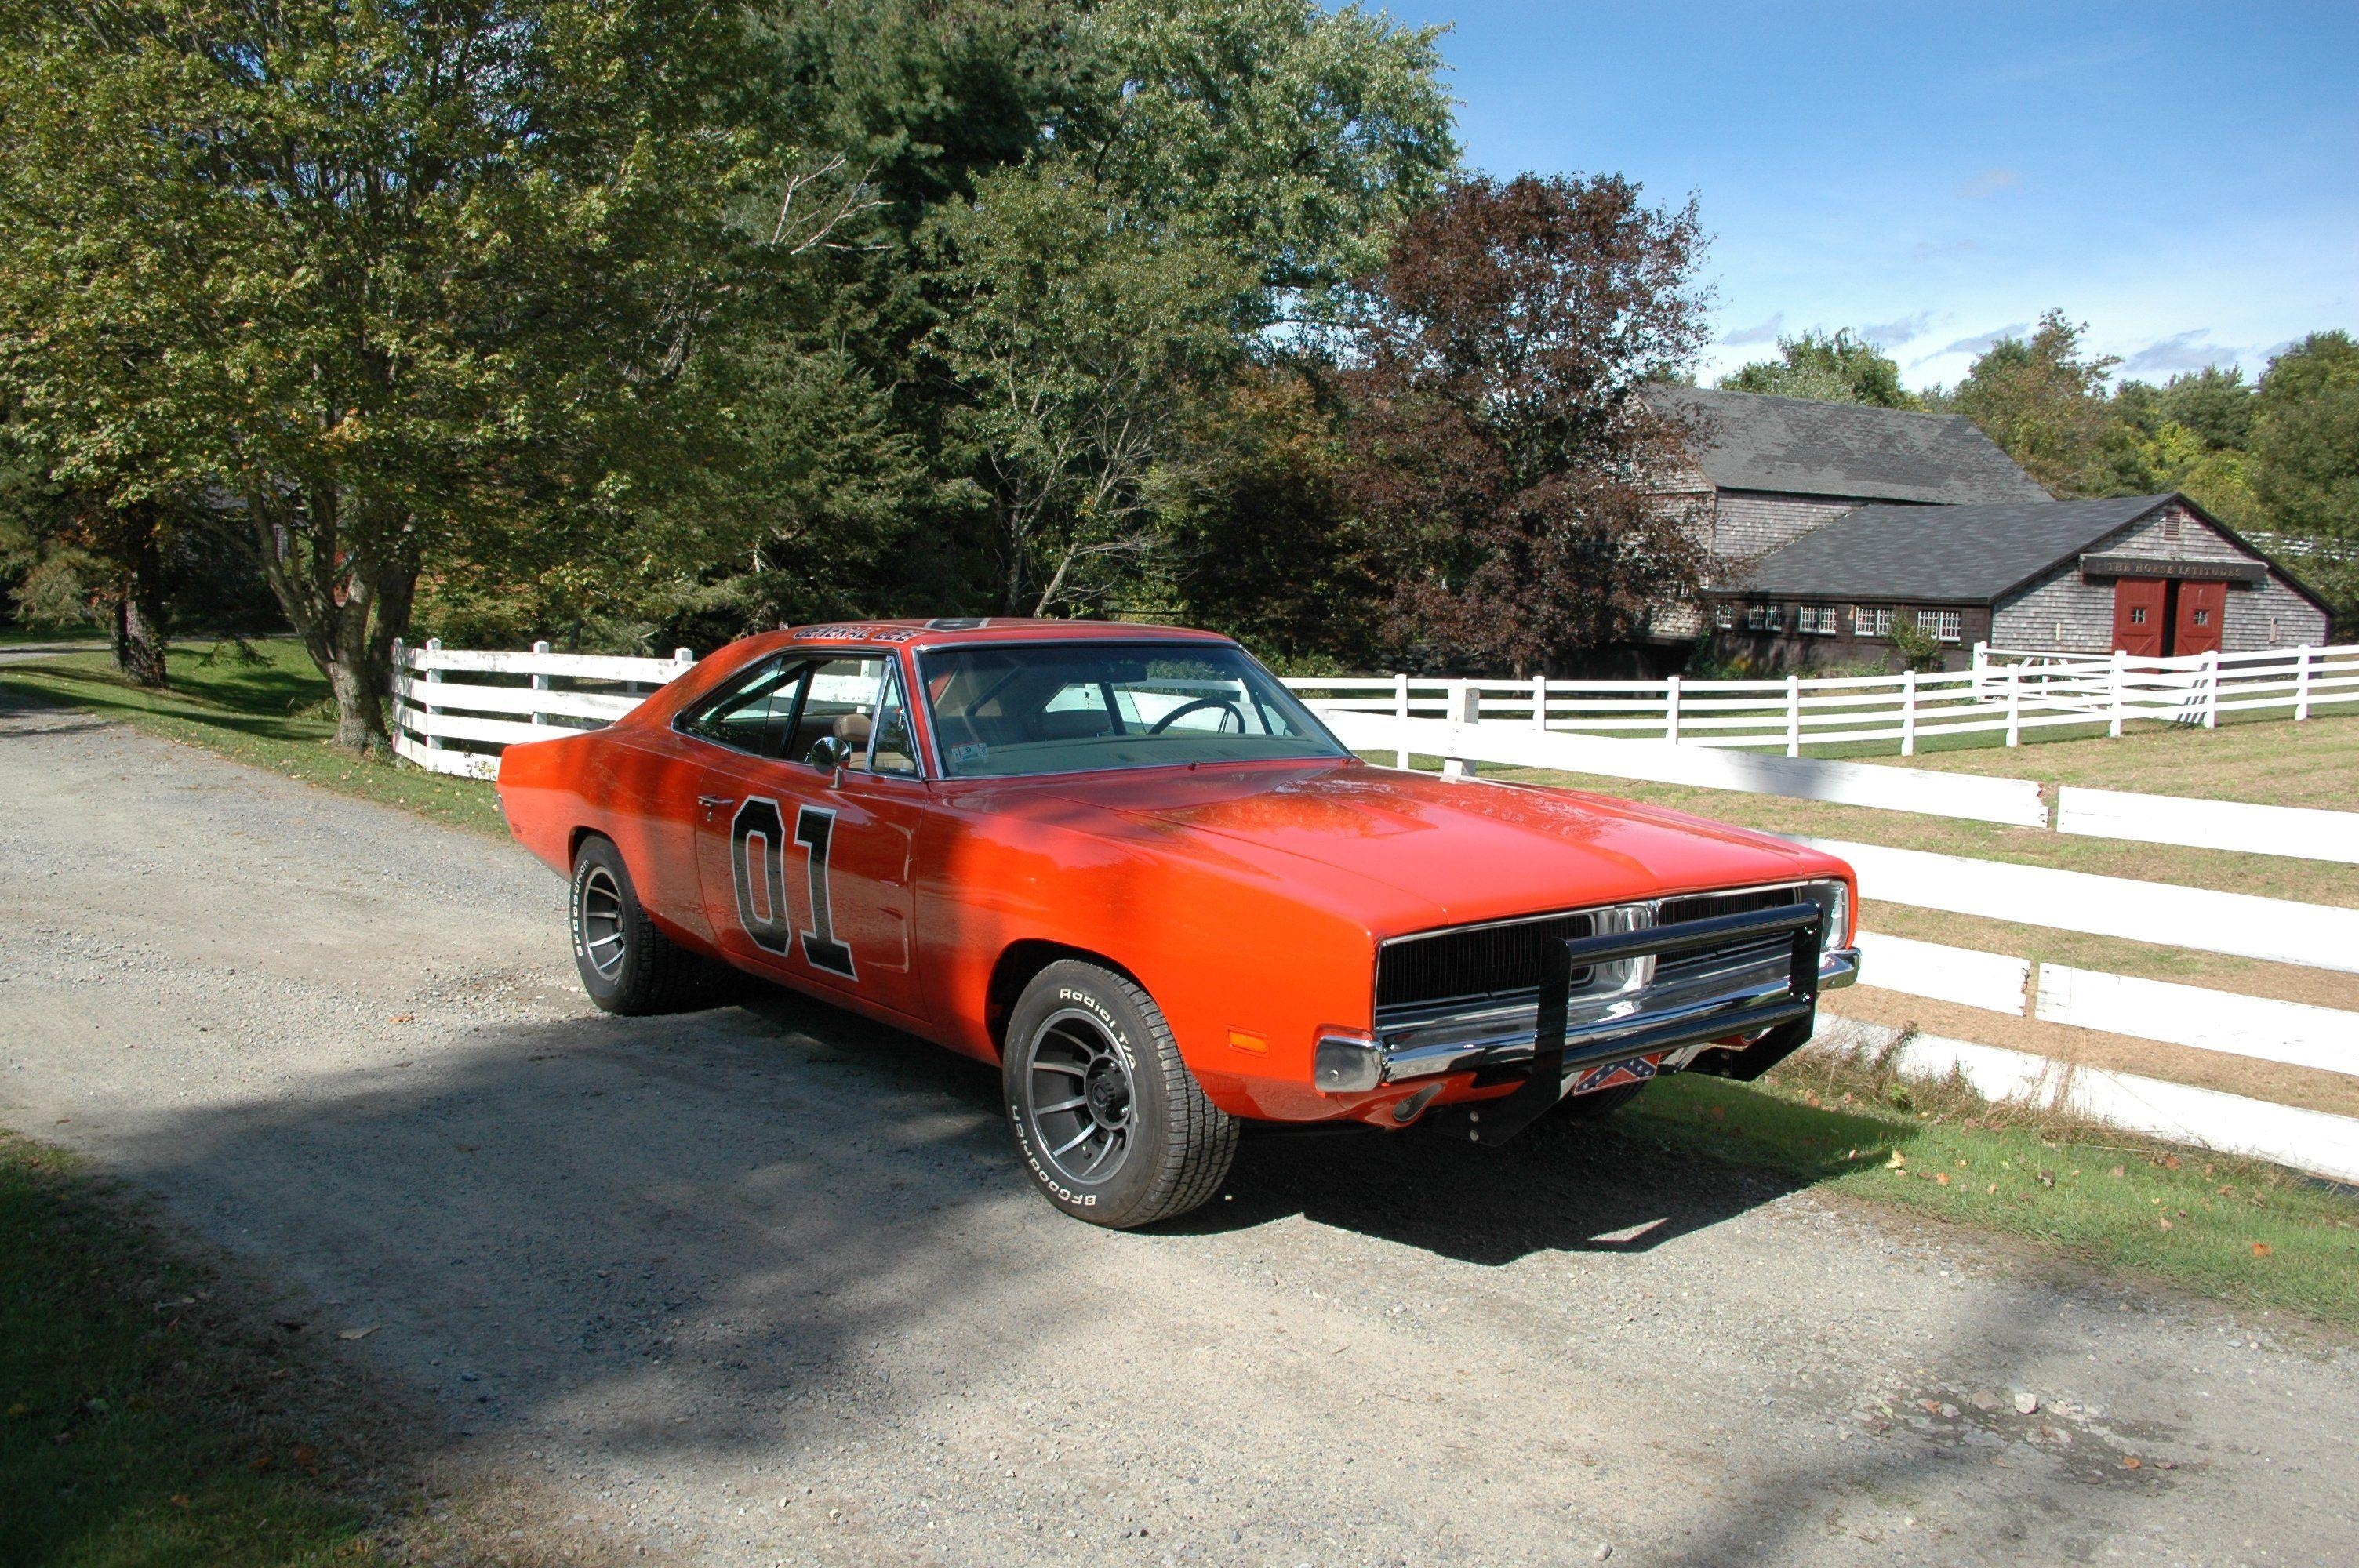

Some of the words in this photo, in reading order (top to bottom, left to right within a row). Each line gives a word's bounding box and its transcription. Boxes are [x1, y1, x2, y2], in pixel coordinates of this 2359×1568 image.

[2107, 561, 2132, 572] THE
[2135, 563, 2174, 575] HORSE
[2179, 564, 2243, 577] LATITUDES
[730, 795, 859, 982] 01
[1060, 988, 1117, 1028] Radial
[1119, 1031, 1136, 1071] T/A
[1012, 1105, 1096, 1206] BFGoodrich
